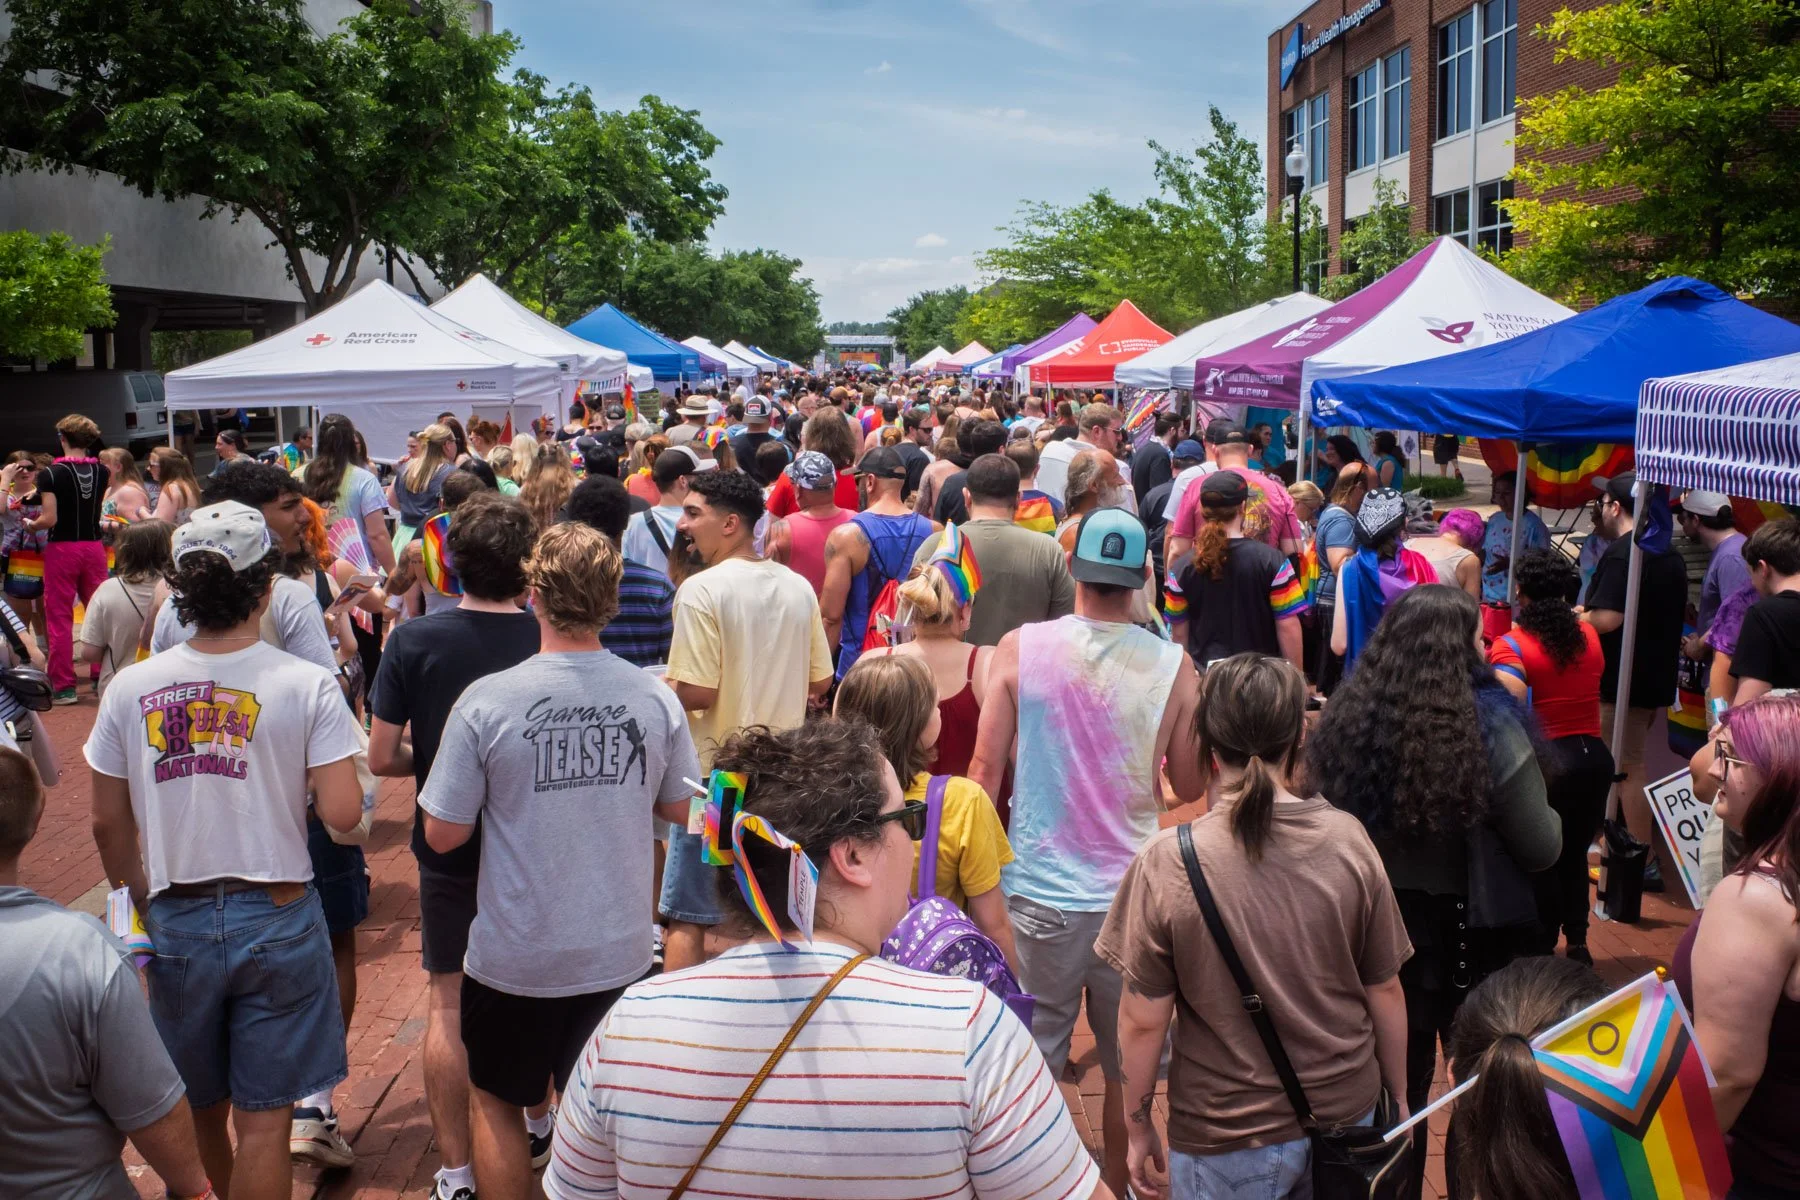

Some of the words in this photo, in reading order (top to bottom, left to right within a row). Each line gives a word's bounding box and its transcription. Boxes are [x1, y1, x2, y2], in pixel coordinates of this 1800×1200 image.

[1301, 37, 1320, 59] Private
[1319, 20, 1340, 46] Wealth
[1339, 0, 1381, 34] Management
[174, 539, 205, 560] AUGUST
[218, 543, 238, 561] 1994
[13, 573, 41, 584] heritage
[143, 684, 210, 713] STREET
[166, 705, 186, 755] ROD
[522, 696, 630, 740] Garage
[531, 724, 621, 785] TEASE
[534, 778, 618, 793] GarageTease.com
[1664, 788, 1697, 817] PR
[799, 869, 807, 906] TEMPLE
